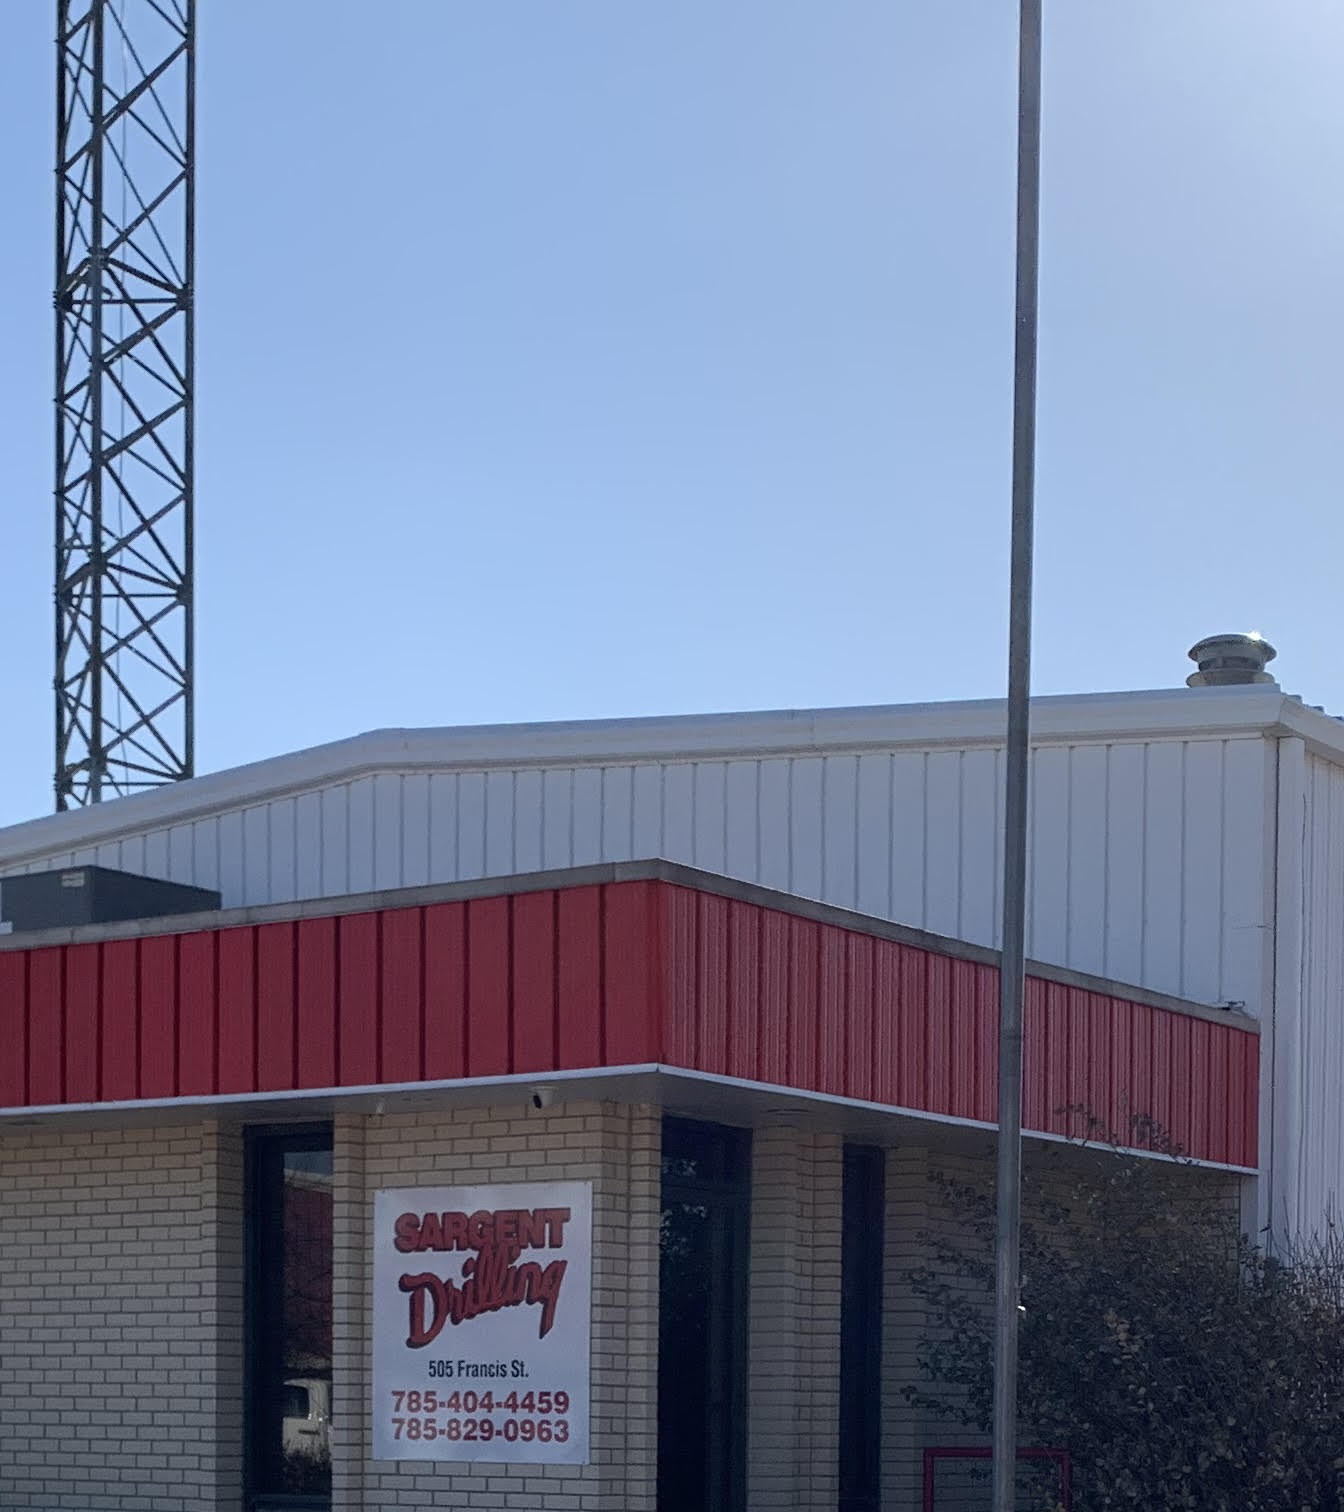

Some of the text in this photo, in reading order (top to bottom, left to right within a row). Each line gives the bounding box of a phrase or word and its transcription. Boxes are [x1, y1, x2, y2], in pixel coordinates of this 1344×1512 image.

[394, 1207, 571, 1253] SARGENT
[398, 1244, 567, 1349] Drilling
[428, 1359, 529, 1378] 505 Francis St.
[391, 1390, 570, 1414] 785-404-4459
[391, 1418, 570, 1443] 785-829-0963
